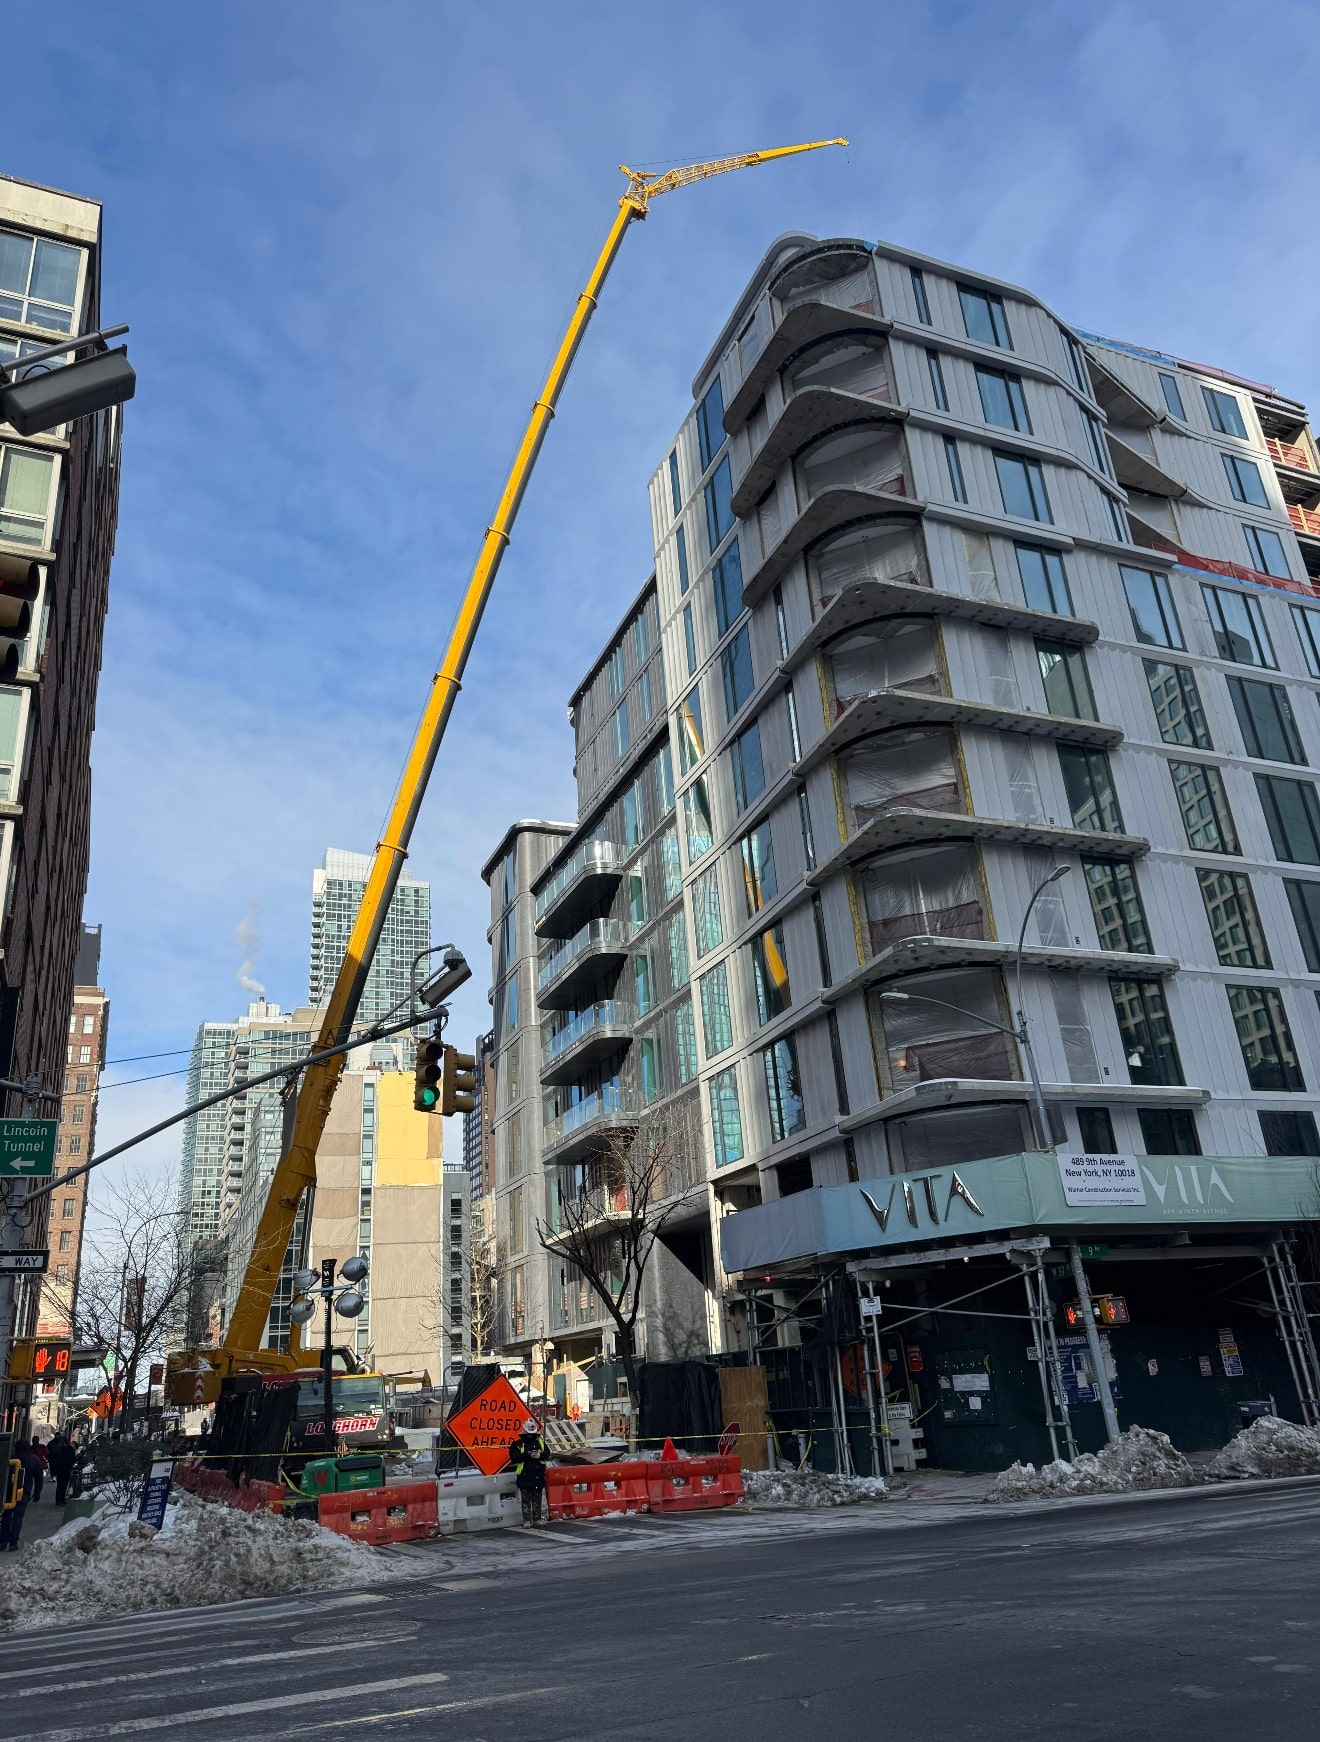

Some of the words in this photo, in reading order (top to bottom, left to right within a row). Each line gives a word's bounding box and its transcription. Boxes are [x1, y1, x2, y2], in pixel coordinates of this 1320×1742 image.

[3, 1140, 45, 1152] Tunnel
[1071, 1157, 1085, 1166] 489
[1086, 1157, 1098, 1166] 9th
[1099, 1157, 1126, 1167] Avenue
[1065, 1168, 1082, 1177] New
[1083, 1168, 1102, 1179] York,
[1102, 1168, 1112, 1177] NY
[1113, 1168, 1136, 1178] 10018
[1141, 1164, 1236, 1205] VITA
[859, 1169, 985, 1234] VITA
[1088, 1246, 1094, 1256] 9
[15, 1256, 39, 1267] WAY
[55, 1350, 69, 1371] 18
[480, 1399, 517, 1413] ROAD
[305, 1417, 380, 1436] LOGHORN
[469, 1417, 522, 1432] CLOSED
